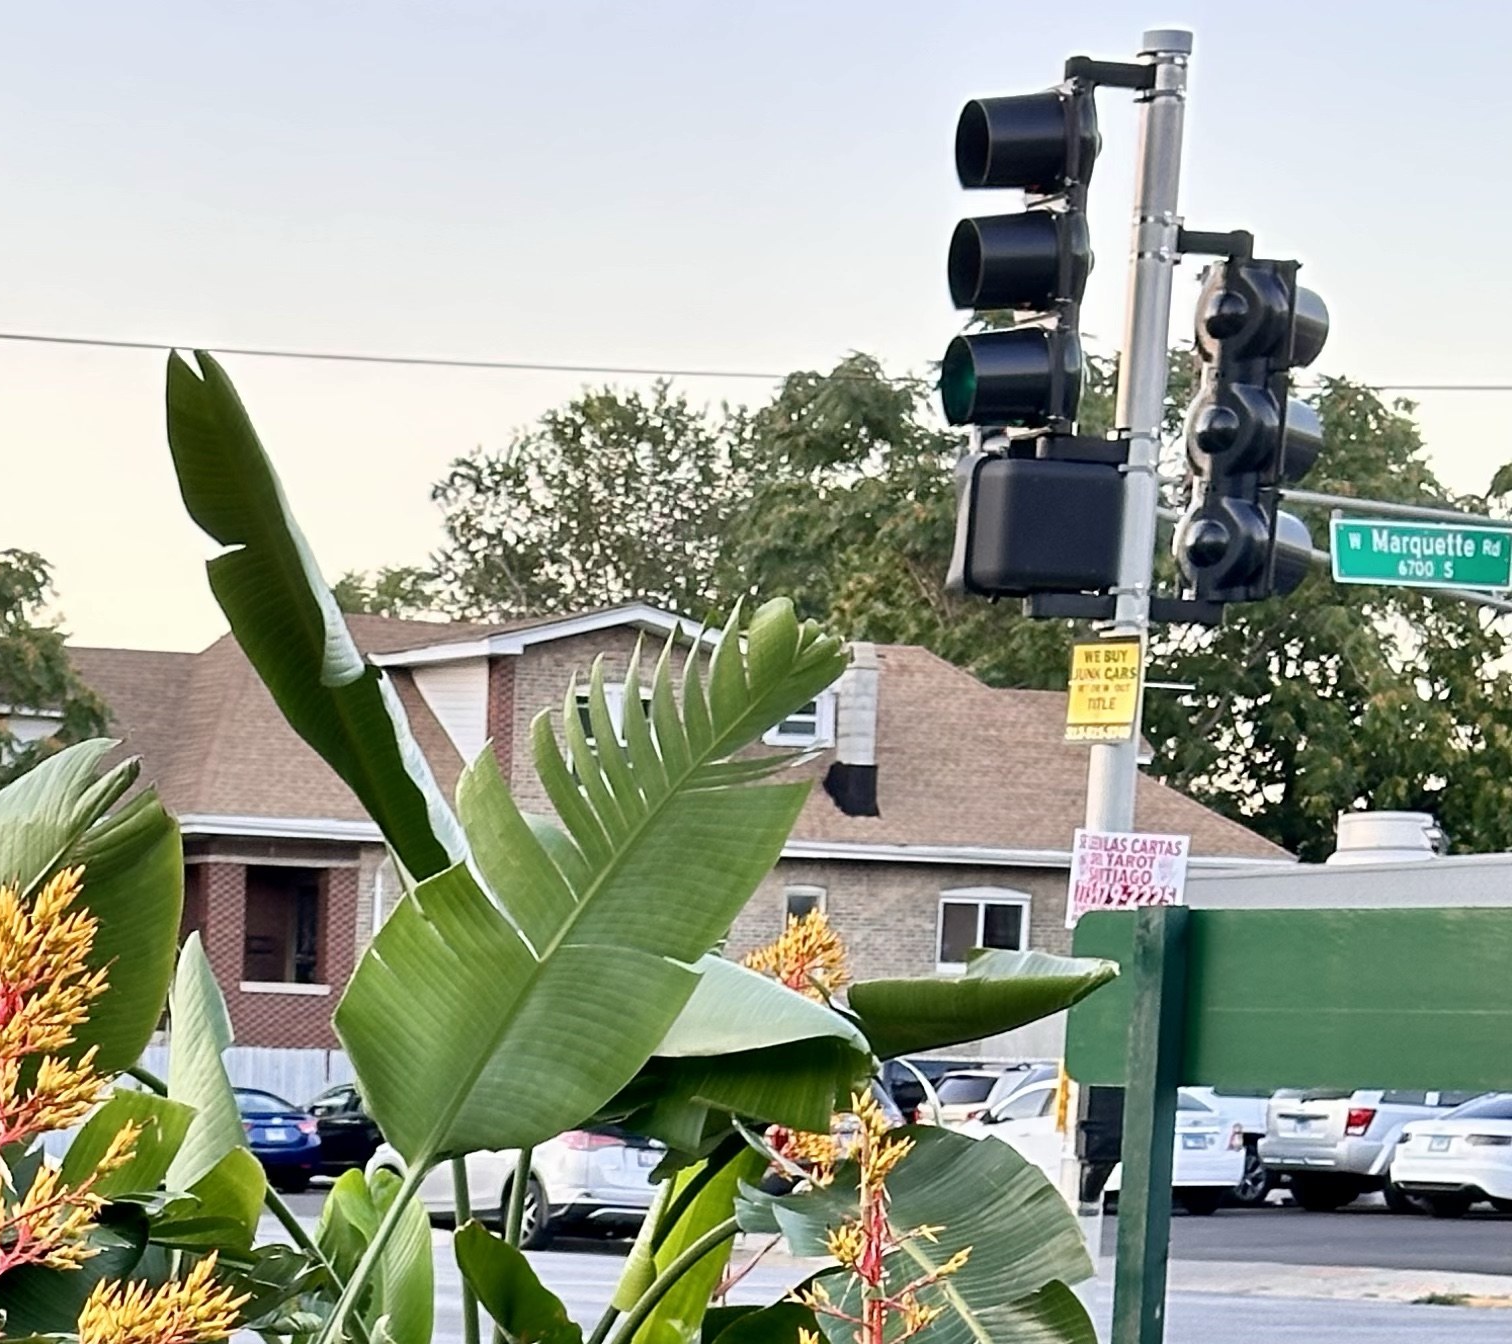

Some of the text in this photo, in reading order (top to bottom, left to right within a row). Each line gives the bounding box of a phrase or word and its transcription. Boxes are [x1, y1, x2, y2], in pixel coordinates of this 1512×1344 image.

[1349, 529, 1501, 559] W Marquette Rd
[1398, 560, 1454, 578] 6700 S
[1084, 649, 1128, 663] WE BUY
[1104, 666, 1137, 681] CARS
[1088, 697, 1116, 710] TITLE
[1104, 836, 1128, 853] LAS
[1131, 838, 1182, 856] CARTAS
